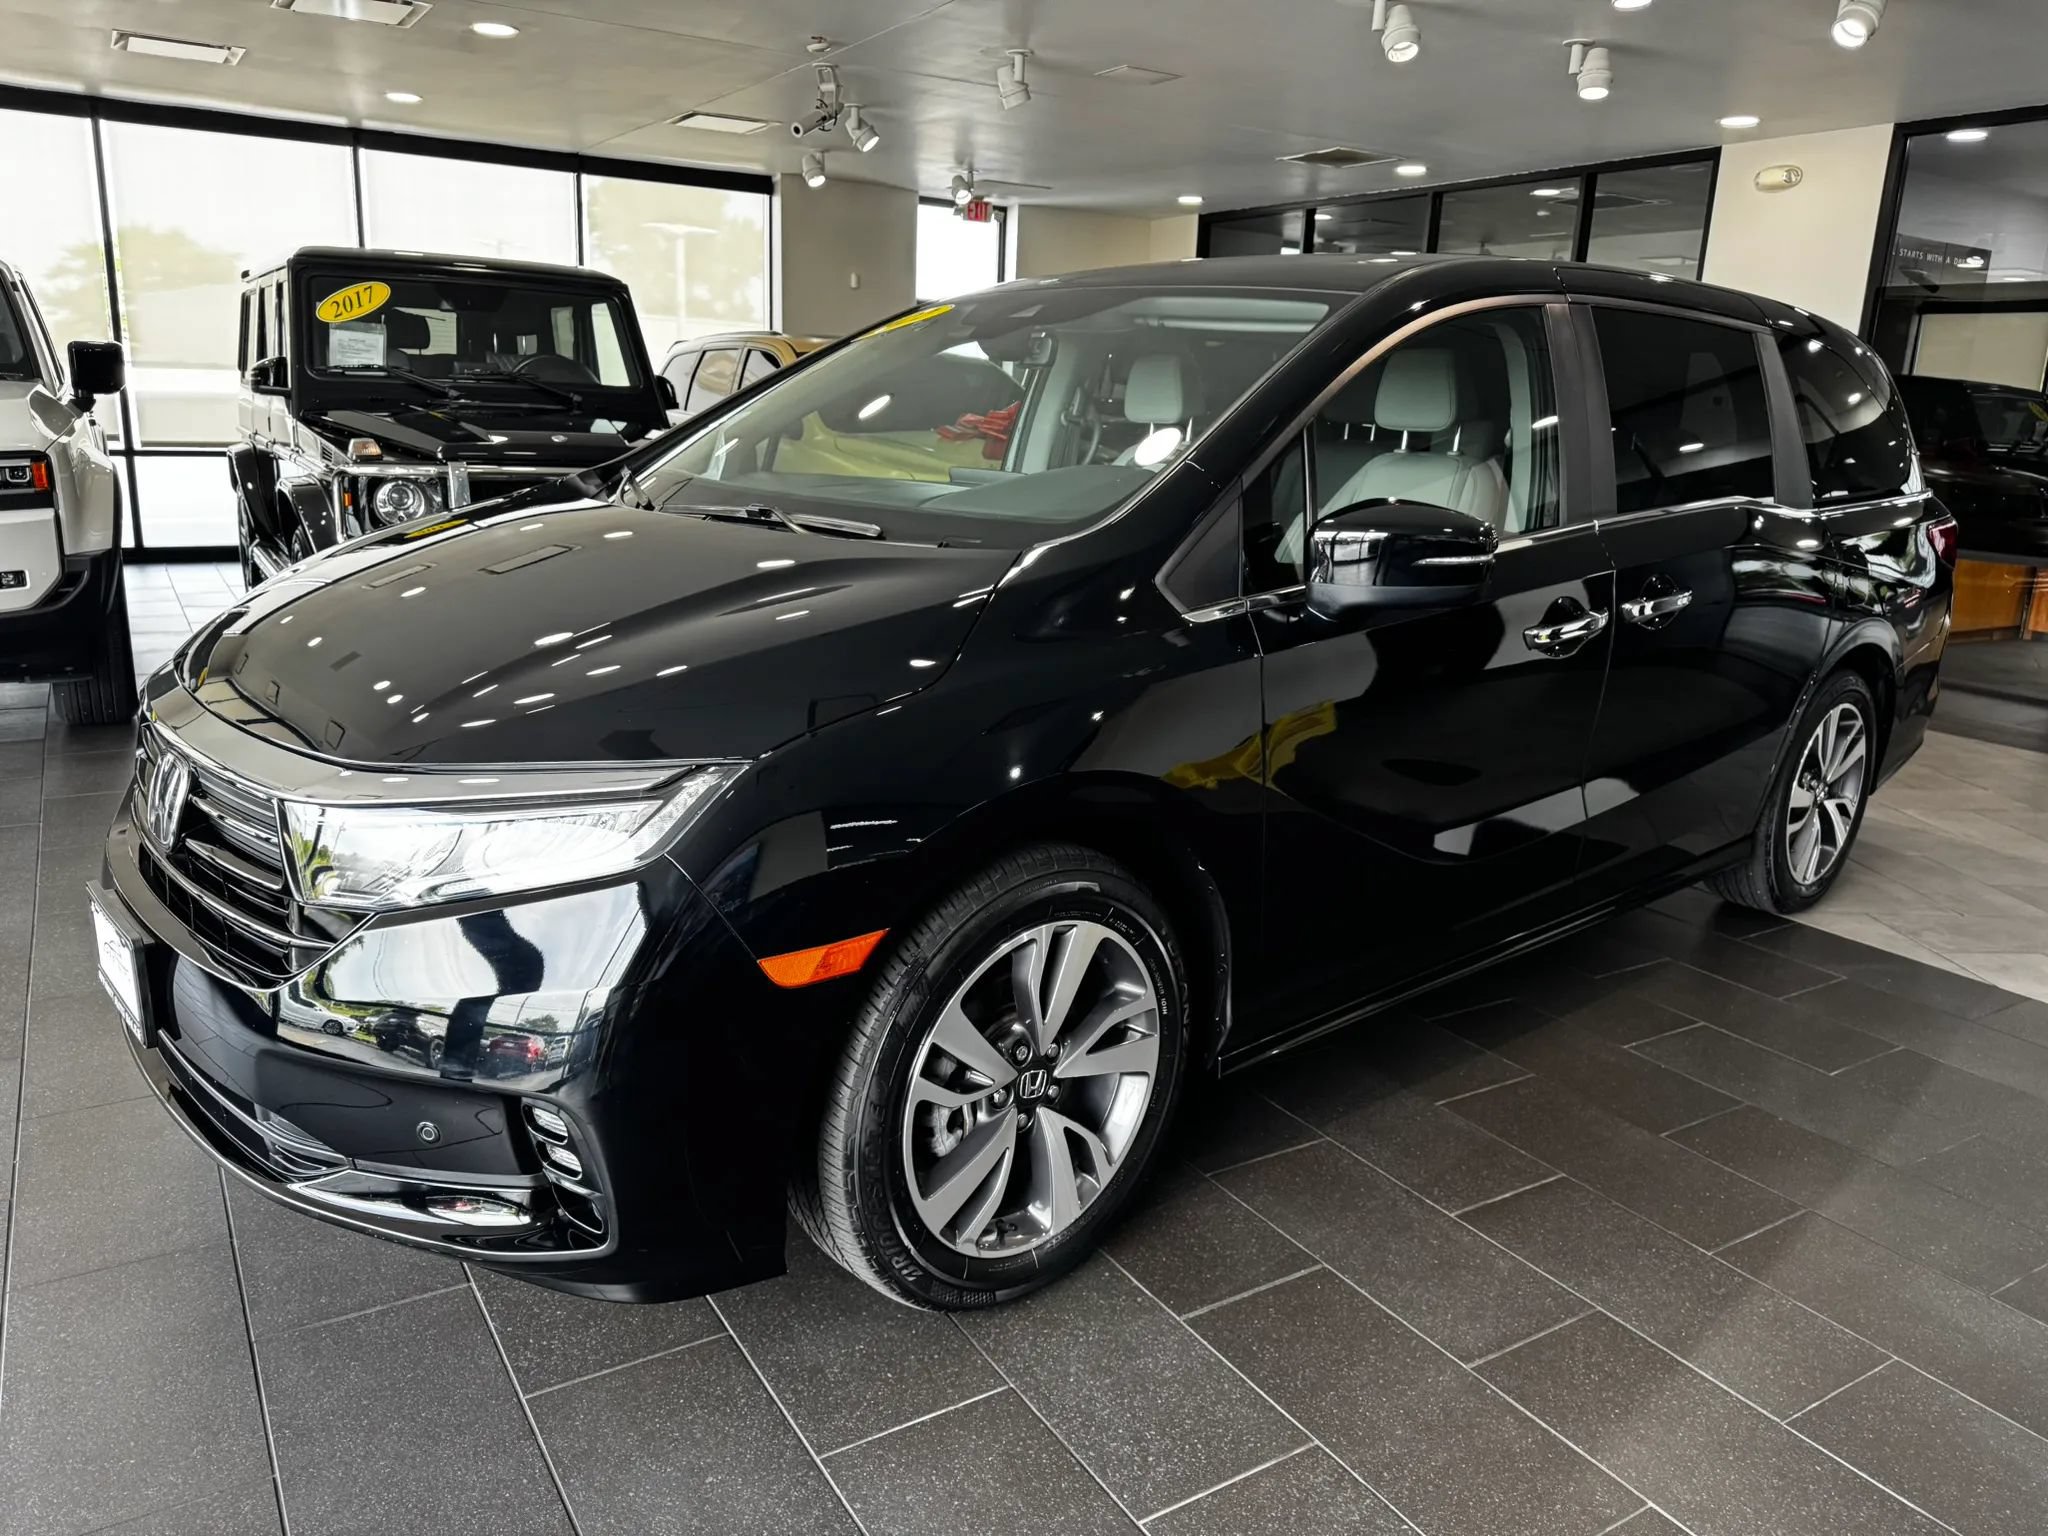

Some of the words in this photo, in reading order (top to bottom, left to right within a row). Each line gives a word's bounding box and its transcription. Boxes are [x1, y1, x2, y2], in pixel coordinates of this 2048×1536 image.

[967, 202, 990, 221] EXIT
[1899, 248, 1924, 260] STARTS
[1926, 252, 1943, 263] WITH
[331, 286, 373, 318] 2017
